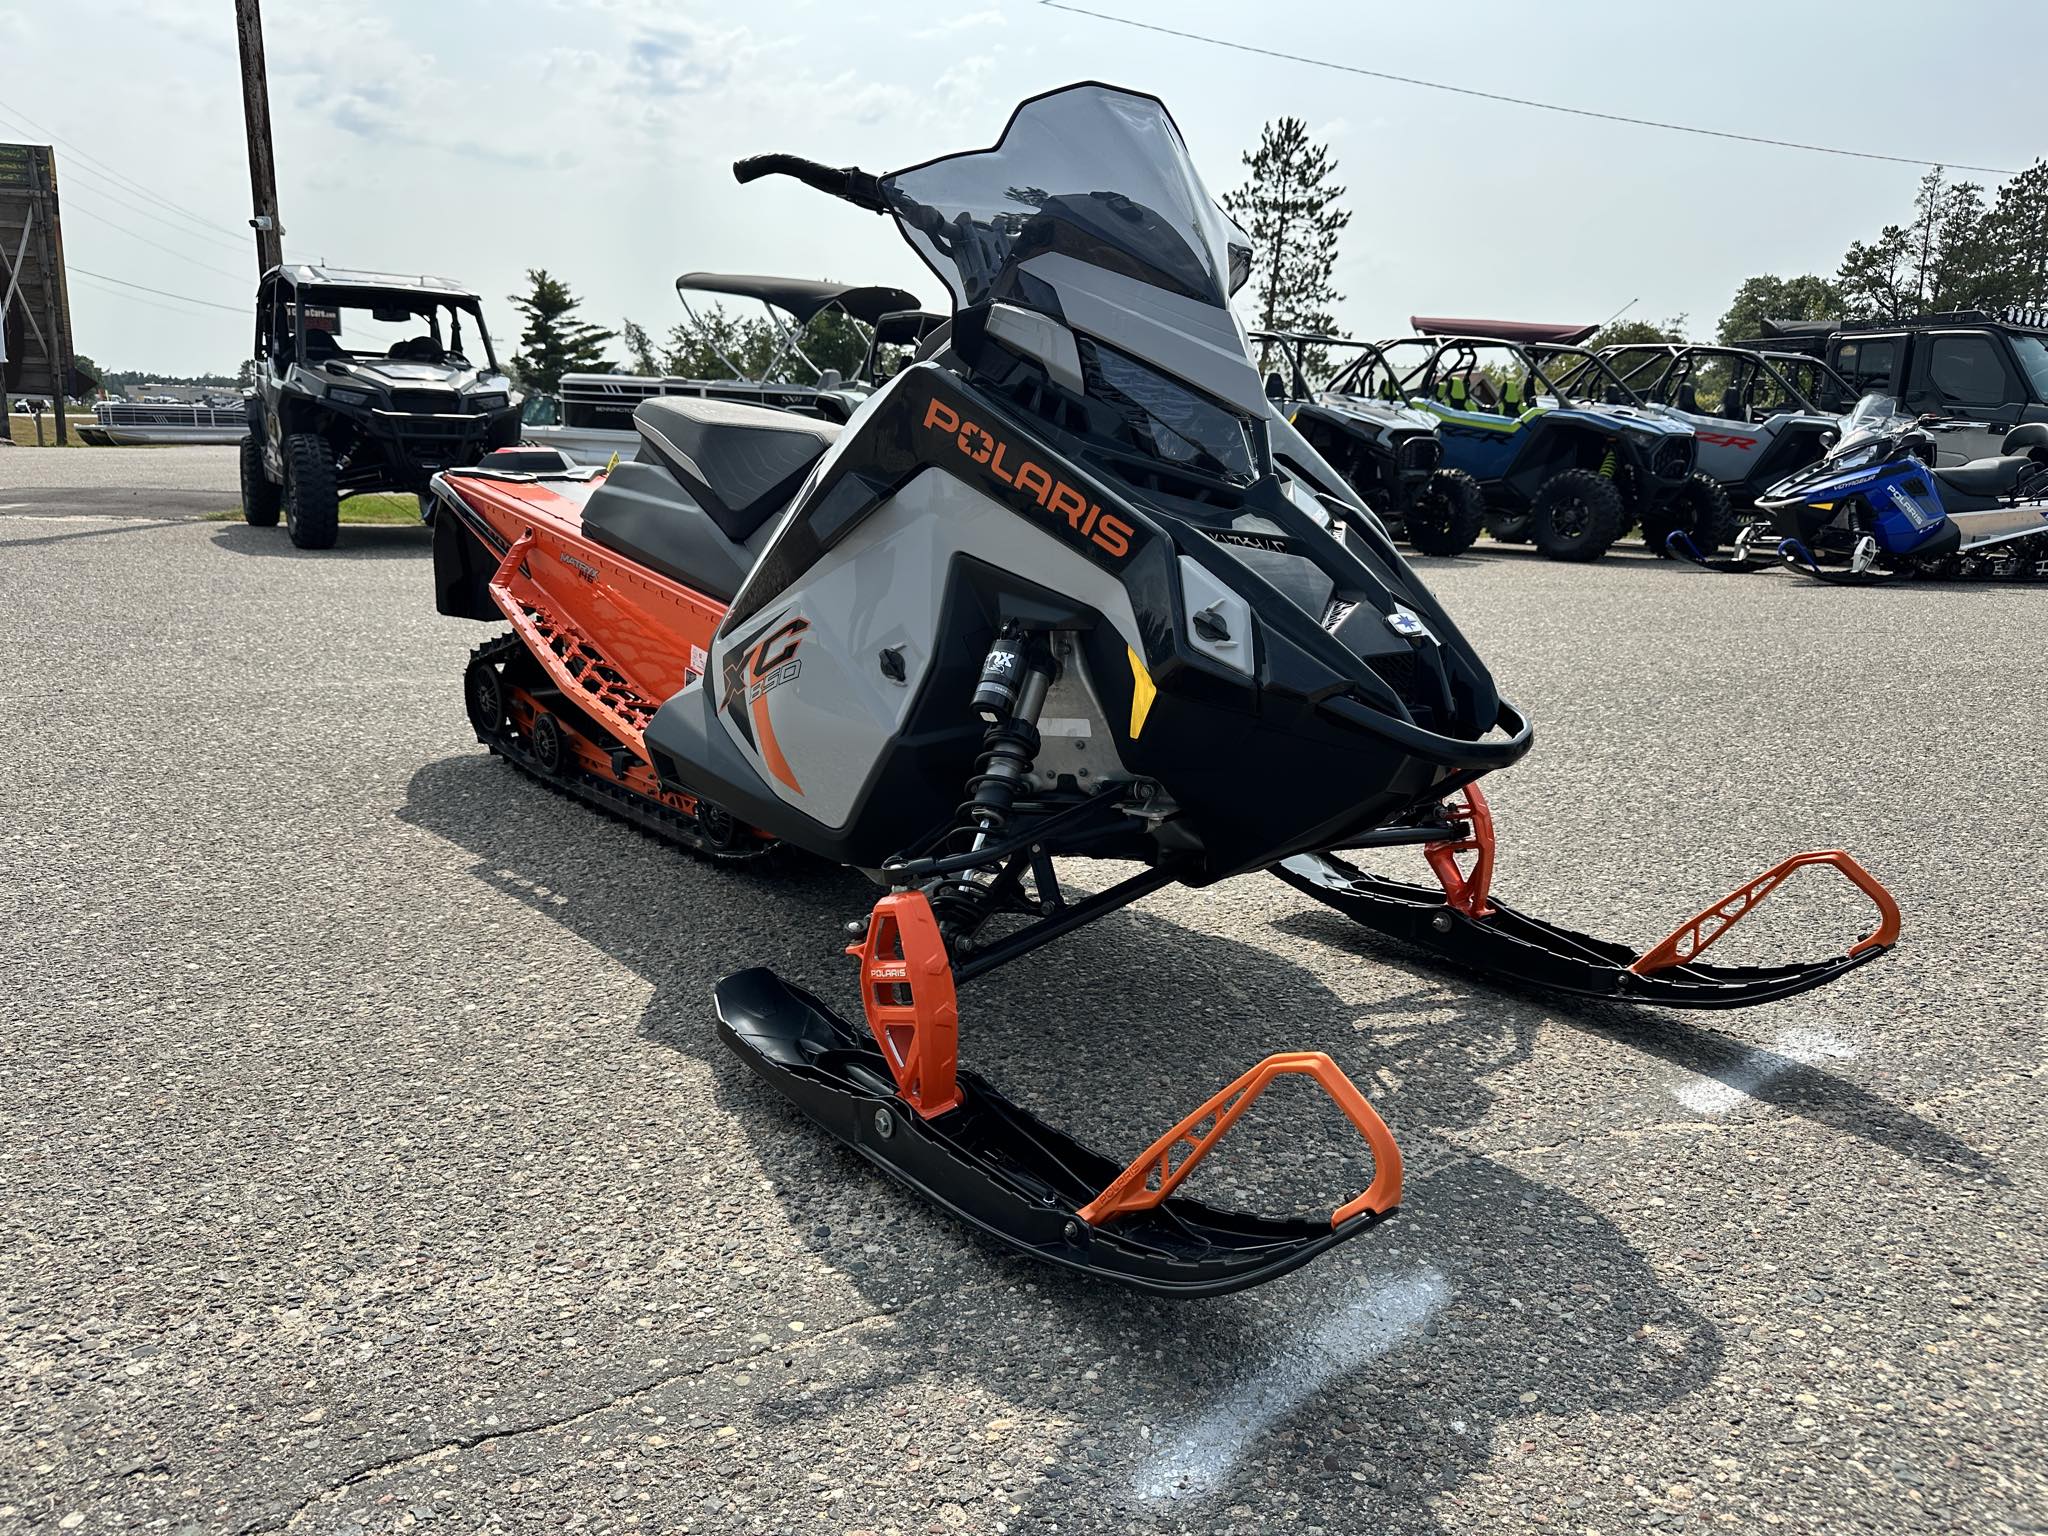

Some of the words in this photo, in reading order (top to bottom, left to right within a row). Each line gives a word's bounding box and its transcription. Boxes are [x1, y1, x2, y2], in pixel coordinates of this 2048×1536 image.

[595, 406, 635, 414] BENNINGTO
[1695, 431, 1758, 450] ZR
[923, 397, 1135, 557] POLARIS
[1886, 484, 1923, 525] POLARIS
[870, 969, 906, 978] POLARIS
[1100, 1162, 1140, 1205] POLARIS
